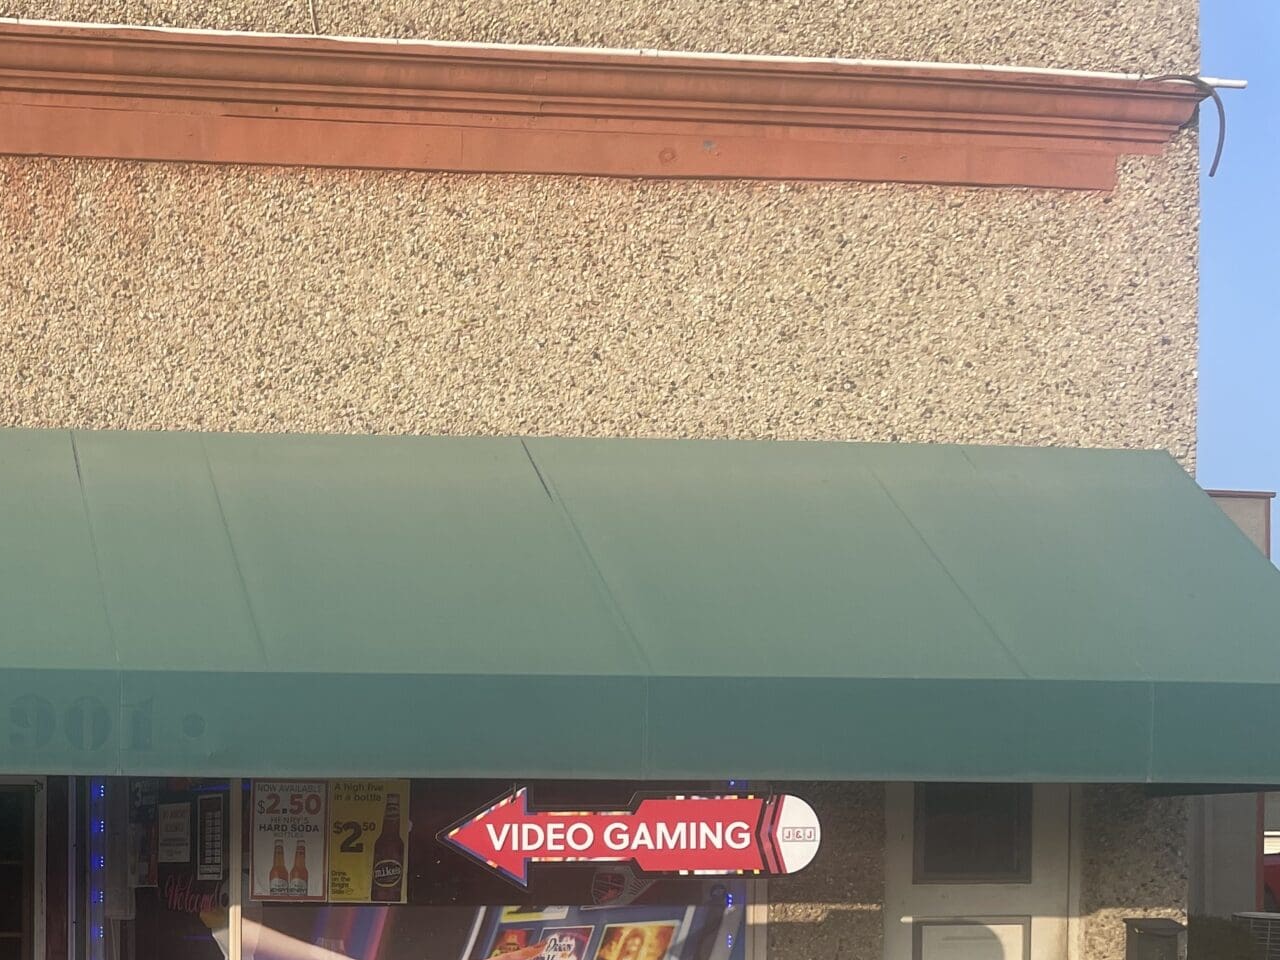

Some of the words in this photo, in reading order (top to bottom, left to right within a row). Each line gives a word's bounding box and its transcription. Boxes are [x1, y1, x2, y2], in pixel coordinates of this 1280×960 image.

[9, 693, 153, 752] 901
[257, 793, 322, 816] $2.50
[259, 824, 288, 832] HARD
[291, 824, 320, 832] SODA
[486, 821, 594, 851] VIDEO
[603, 821, 751, 850] GAMING
